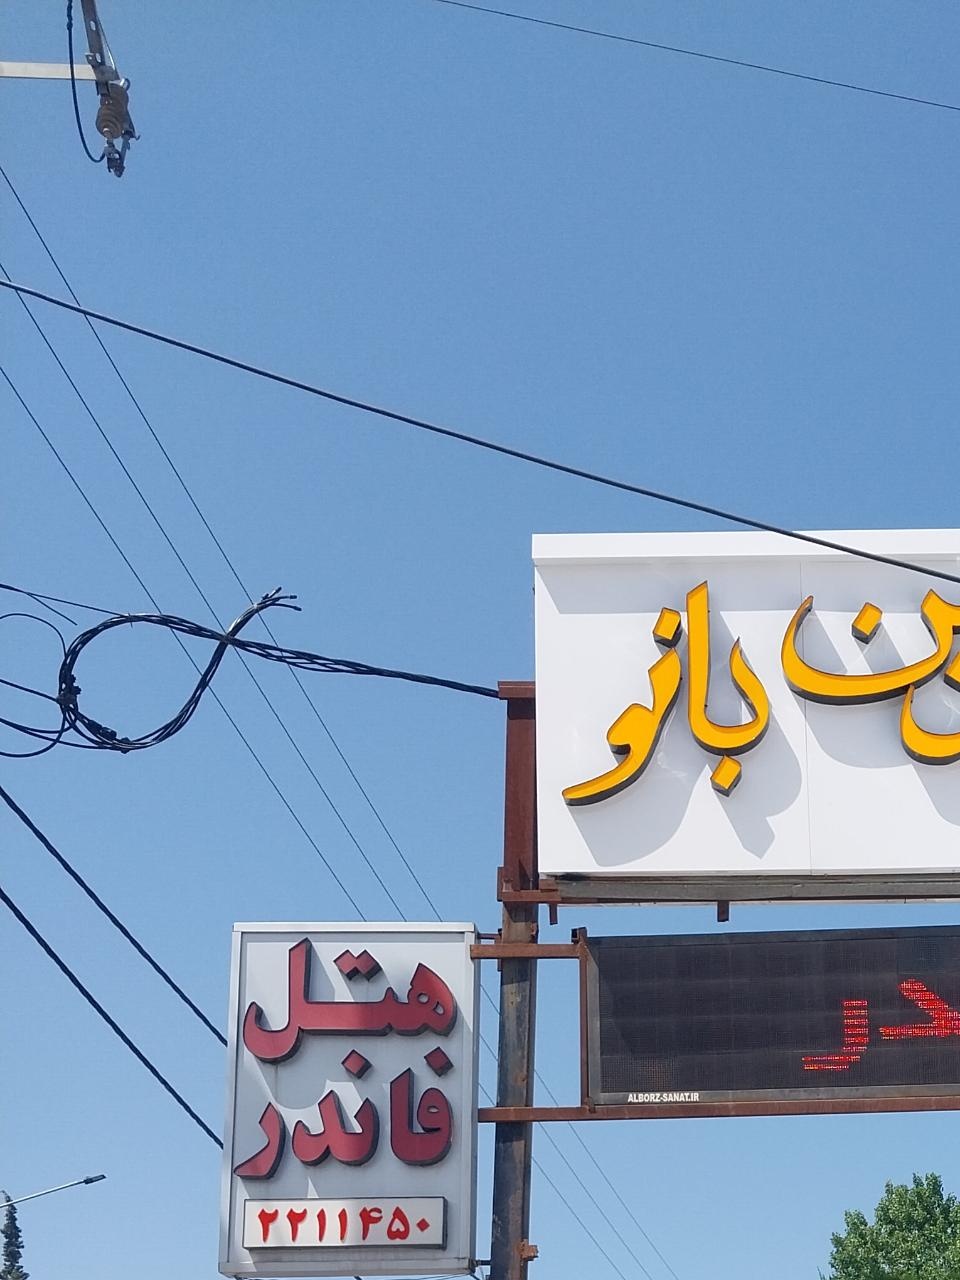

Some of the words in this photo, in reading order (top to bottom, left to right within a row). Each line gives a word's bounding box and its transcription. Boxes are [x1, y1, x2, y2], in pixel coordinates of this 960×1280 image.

[561, 582, 770, 805] بانو
[242, 937, 457, 1064] هتل
[233, 1047, 453, 1180] فاندر
[627, 1092, 700, 1103] ALBORZ-SANAT.IR
[256, 1206, 431, 1243] ۲۲۱۱۴۵۰
